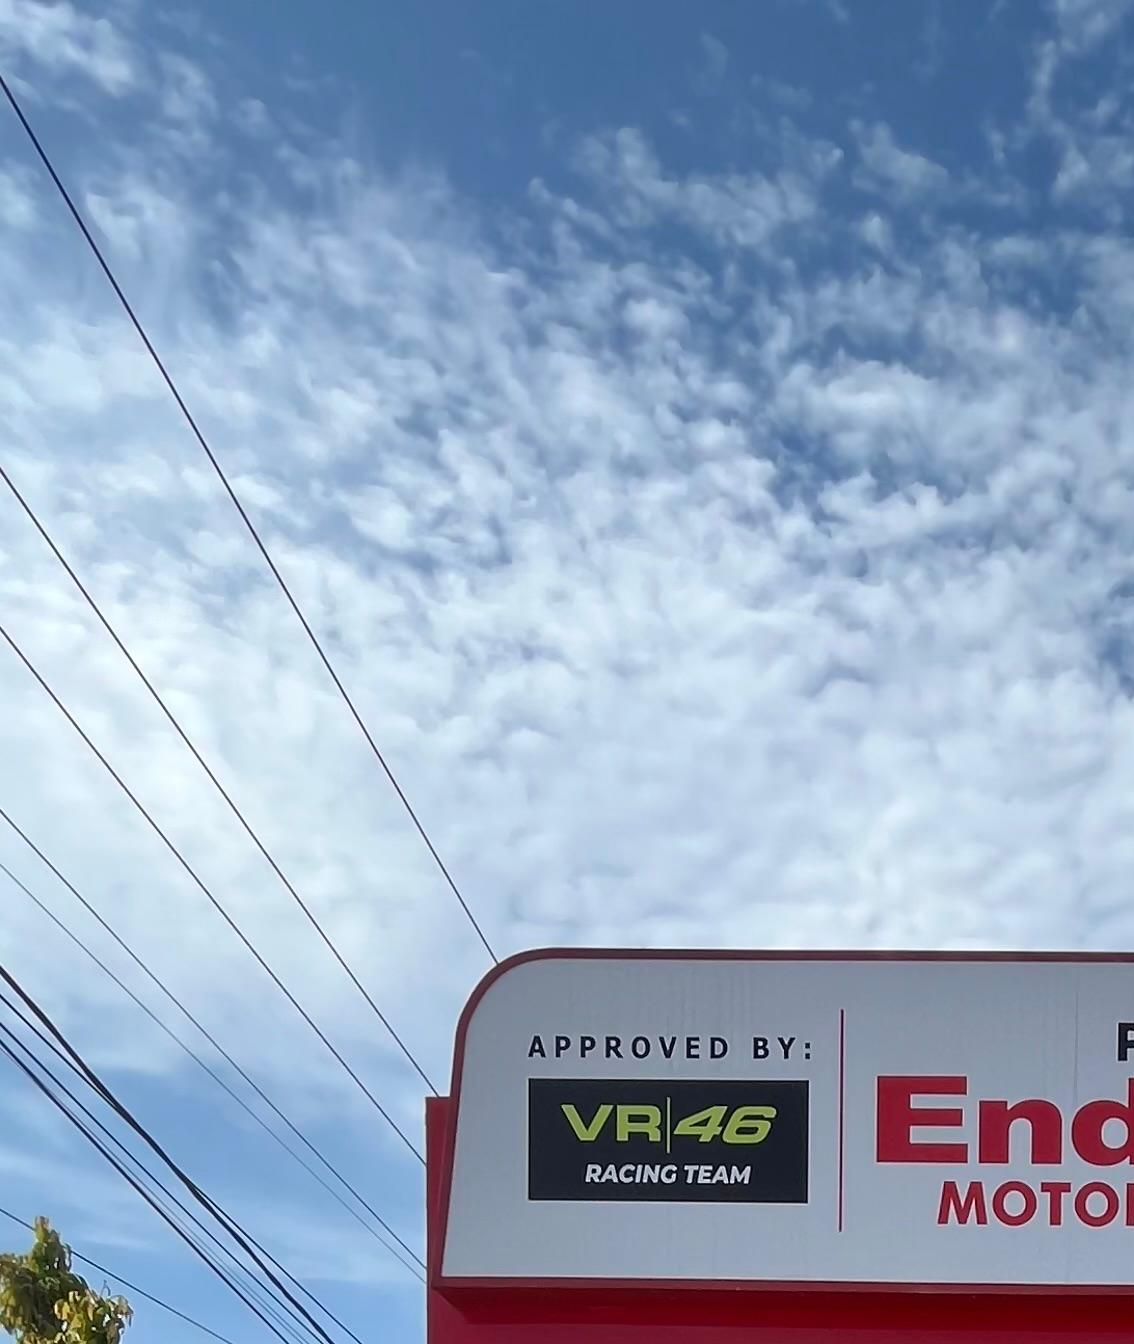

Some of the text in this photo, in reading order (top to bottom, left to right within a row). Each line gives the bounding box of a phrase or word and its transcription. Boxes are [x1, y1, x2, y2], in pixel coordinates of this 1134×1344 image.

[528, 1035, 811, 1060] APPROVED BY:
[585, 1164, 751, 1184] RACING TEAM
